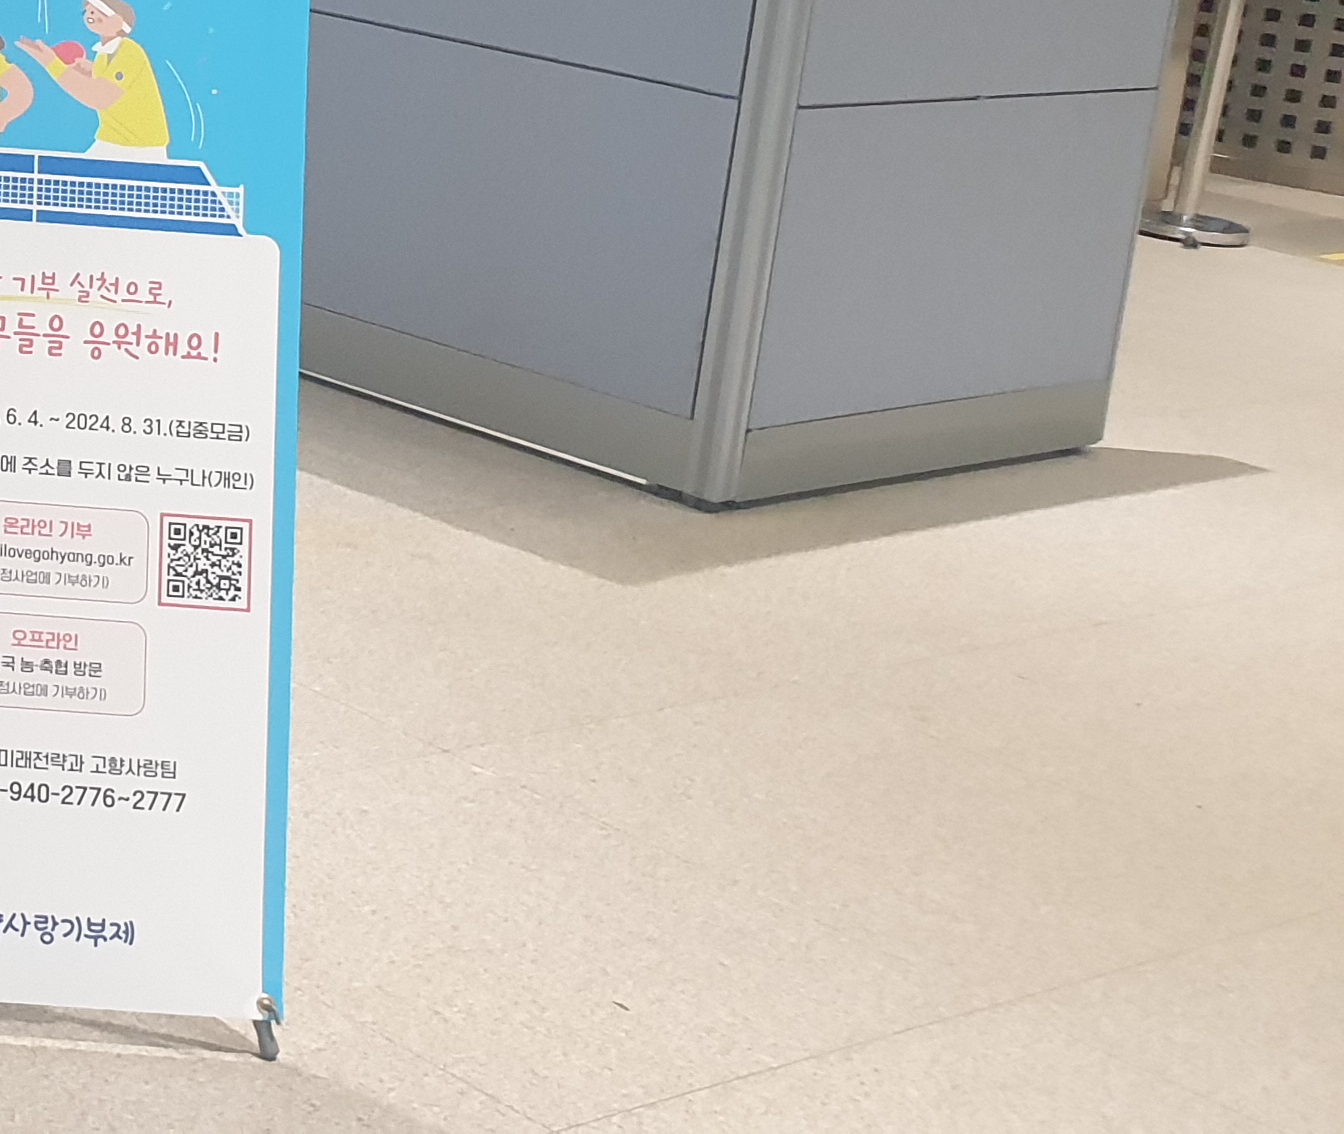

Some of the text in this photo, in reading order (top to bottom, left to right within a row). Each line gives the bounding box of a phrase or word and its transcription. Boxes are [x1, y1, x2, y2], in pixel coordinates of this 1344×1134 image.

[13, 271, 59, 299] 기부
[70, 272, 173, 308] 실천으로,
[83, 321, 220, 362] 응원해요!
[6, 408, 22, 426] 6.
[27, 410, 43, 427] 4.
[65, 412, 115, 433] 2024.
[121, 417, 137, 435] 8.
[21, 456, 71, 477] 주소를
[77, 460, 111, 479] 두지
[117, 463, 151, 483] 않은
[156, 466, 254, 490] 누구나(개인)
[3, 517, 92, 540] 온라인 기부
[55, 572, 110, 589] 기부하기)
[11, 630, 78, 651] 오프라인
[73, 660, 103, 677] 방문
[52, 684, 107, 701] 기부하기)
[89, 755, 177, 779] 고향사랑팀
